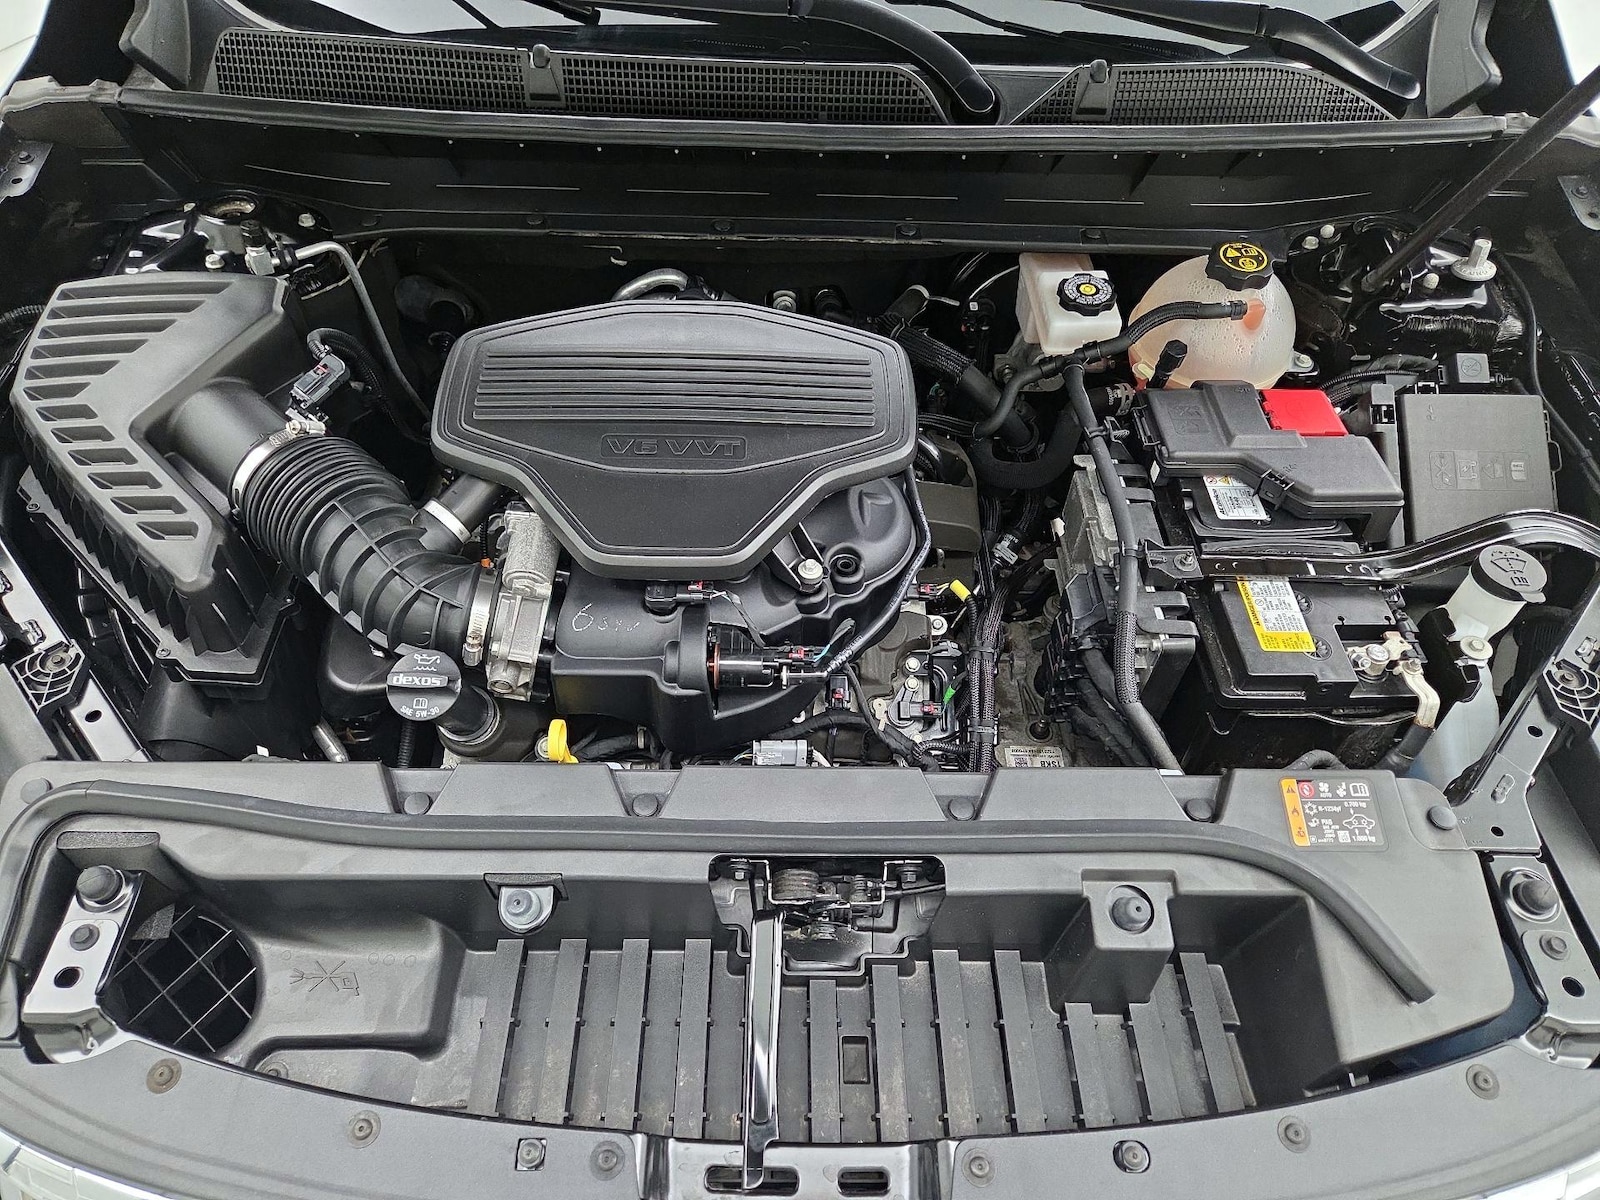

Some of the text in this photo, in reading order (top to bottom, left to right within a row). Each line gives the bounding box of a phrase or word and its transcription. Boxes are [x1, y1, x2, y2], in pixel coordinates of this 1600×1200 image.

[606, 438, 741, 455] V6 VVT
[392, 673, 443, 686] dexos
[400, 705, 440, 717] SAE 5W-30
[1318, 805, 1342, 813] R-1234yf
